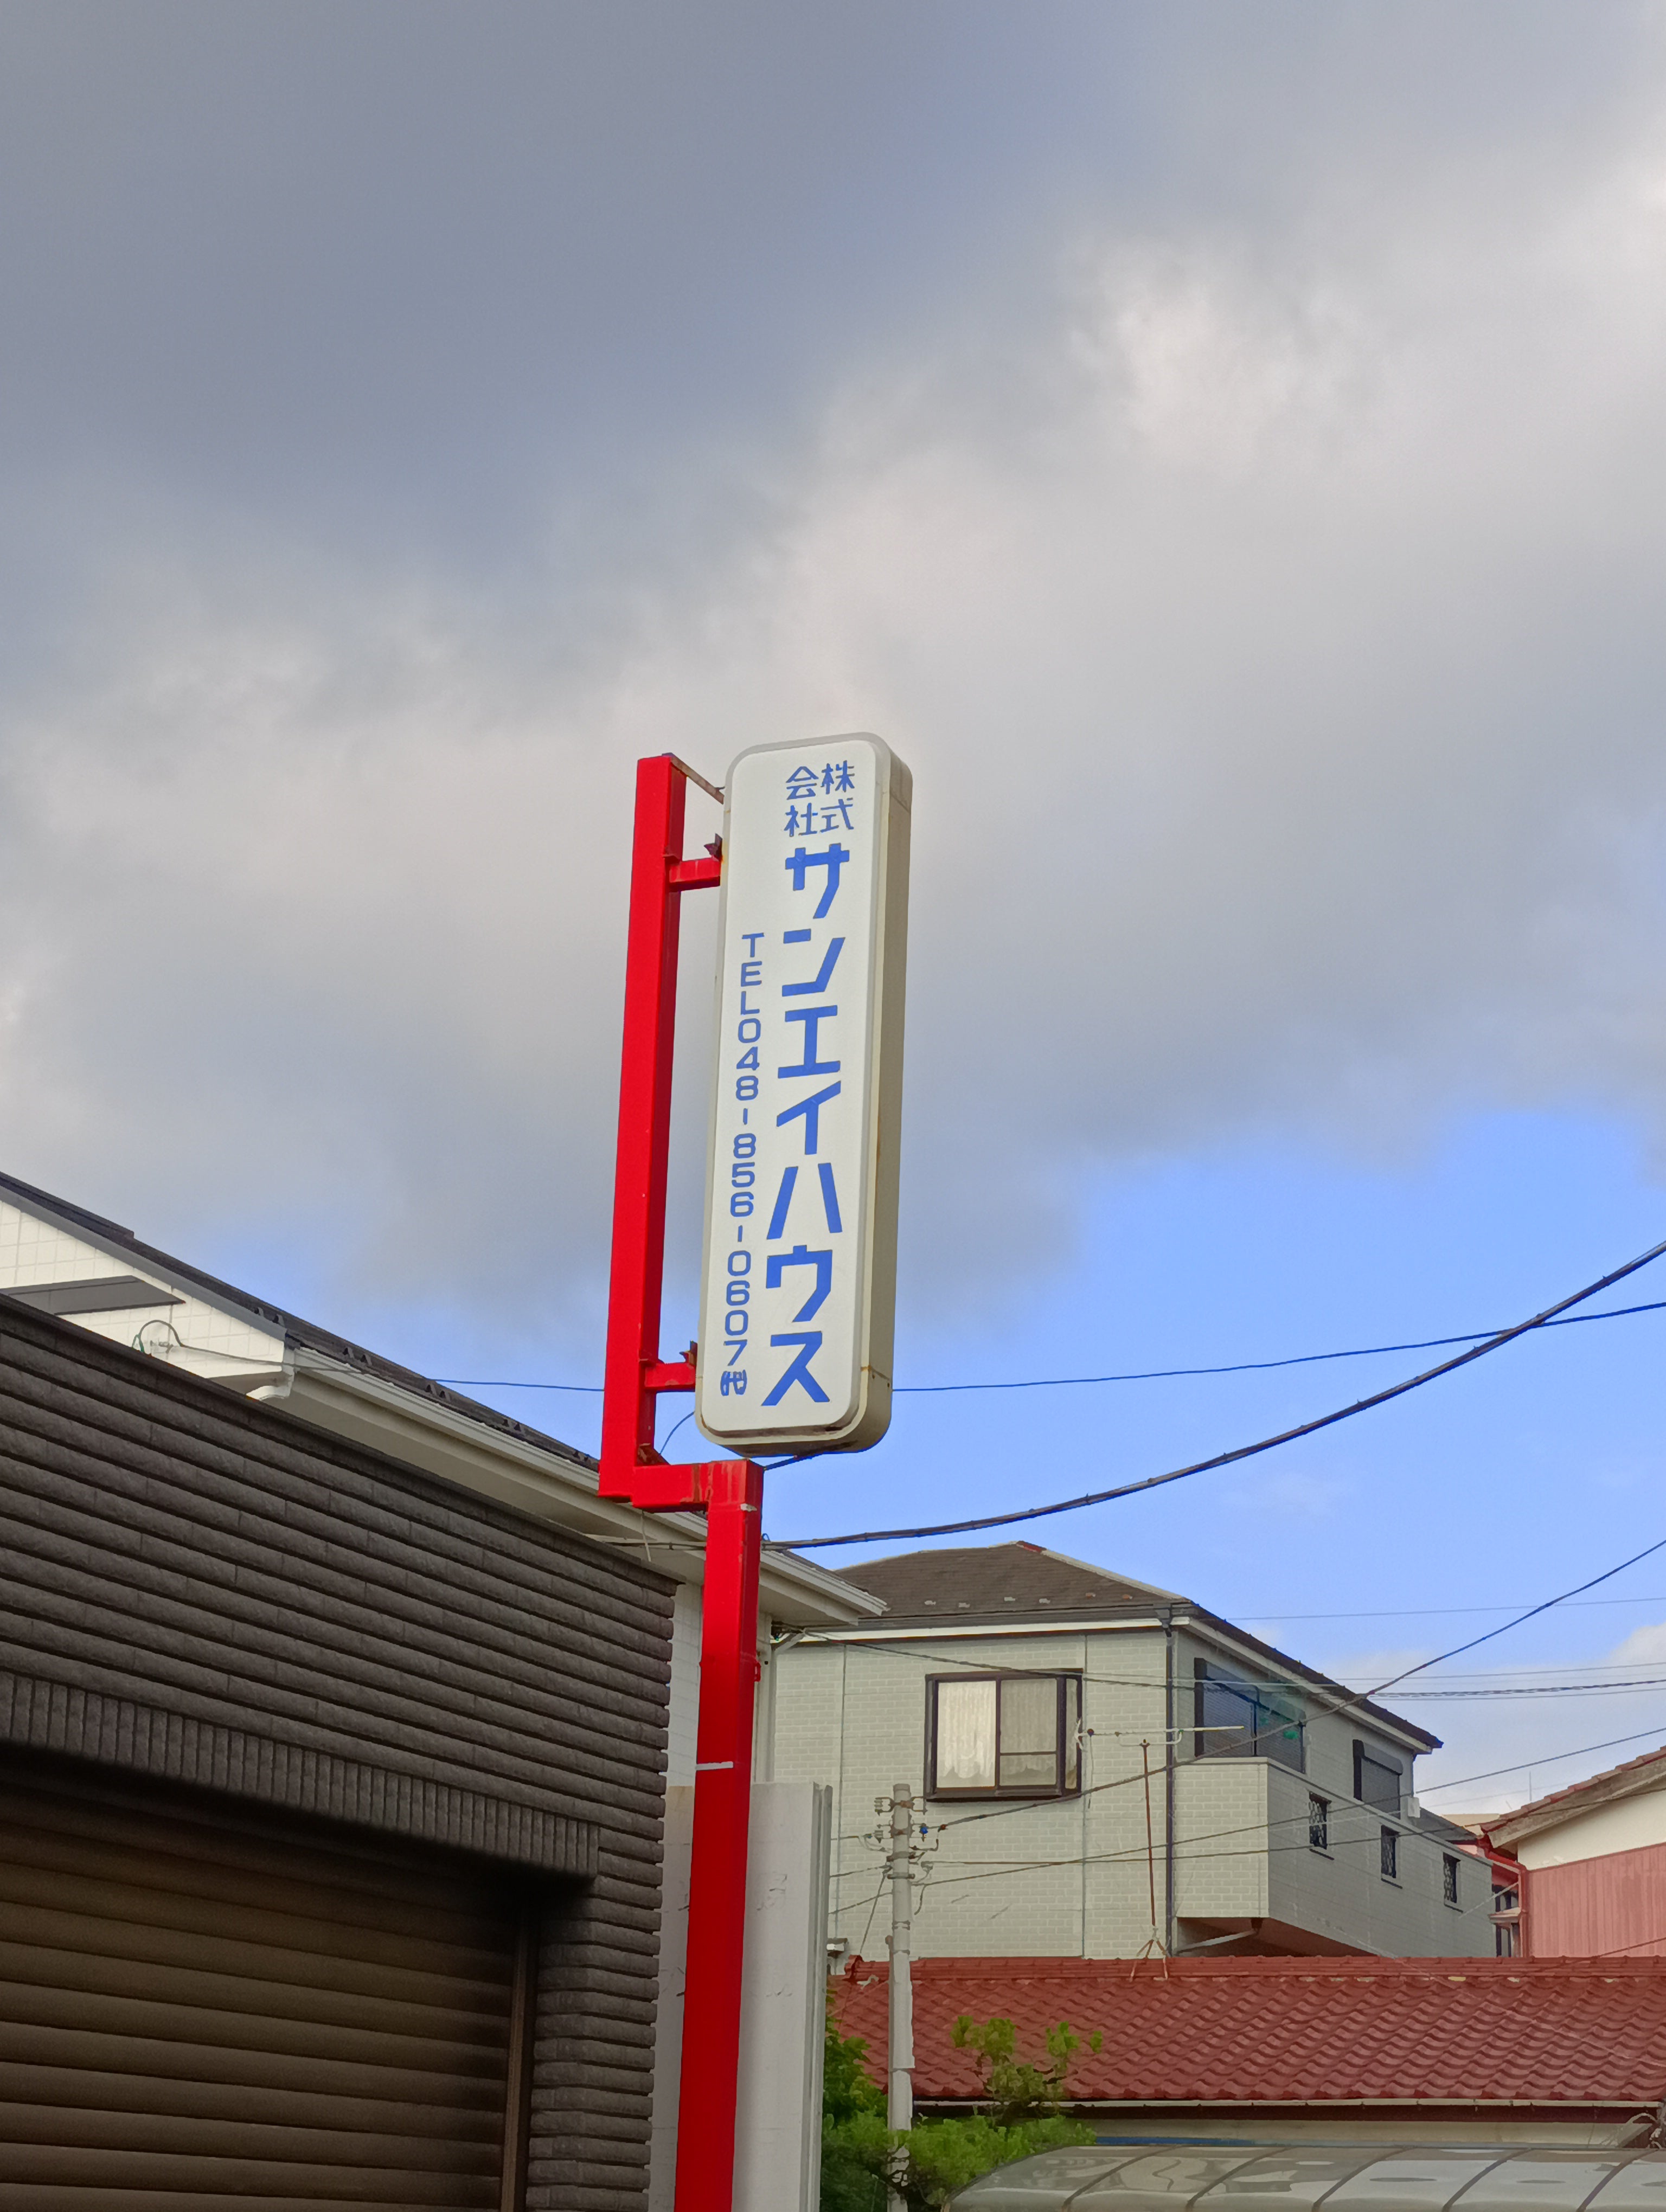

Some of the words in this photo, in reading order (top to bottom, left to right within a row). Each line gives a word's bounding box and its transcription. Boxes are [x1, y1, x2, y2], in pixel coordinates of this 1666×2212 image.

[760, 843, 850, 1406] サンエイハウス
